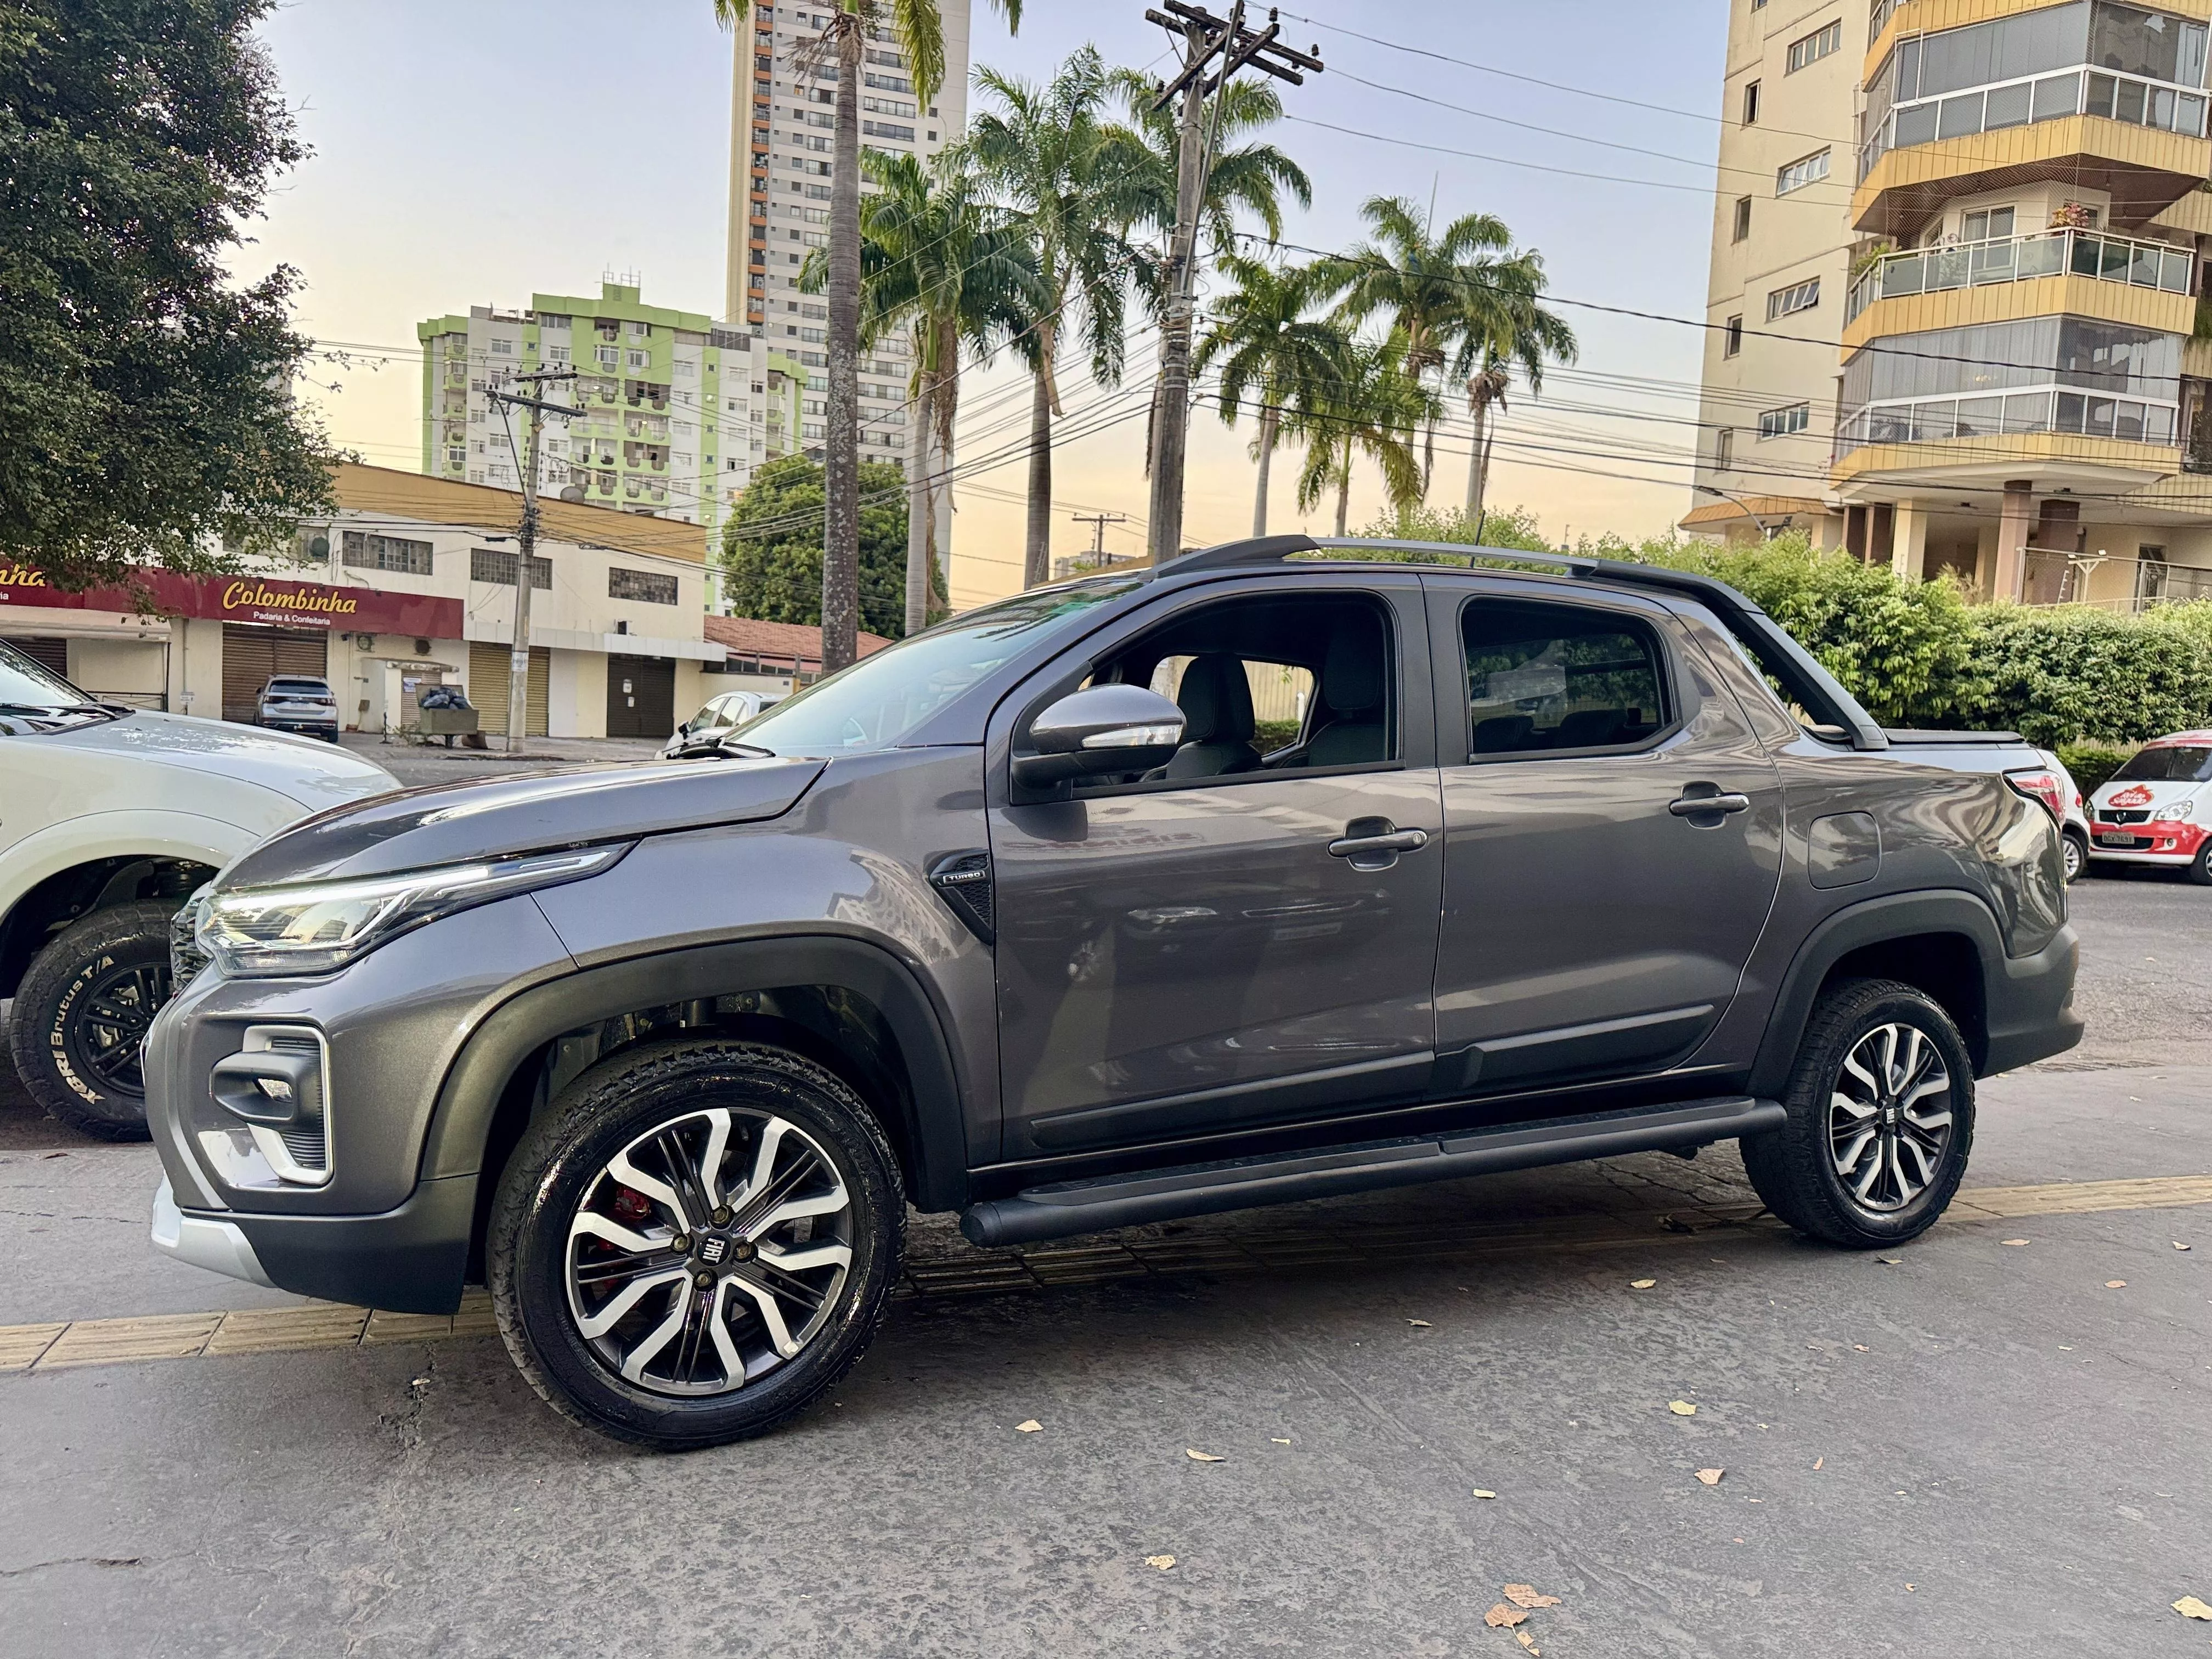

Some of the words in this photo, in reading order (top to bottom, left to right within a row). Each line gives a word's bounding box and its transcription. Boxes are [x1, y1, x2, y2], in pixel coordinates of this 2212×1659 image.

[223, 581, 357, 613] Colombinha
[253, 611, 282, 621] Padaria
[291, 614, 331, 625] Confeitaria
[949, 872, 981, 881] TURBO
[81, 955, 115, 979] T/A
[50, 980, 83, 1046] Brutus
[52, 1049, 106, 1105] XBRI
[702, 1238, 725, 1263] FIAT
